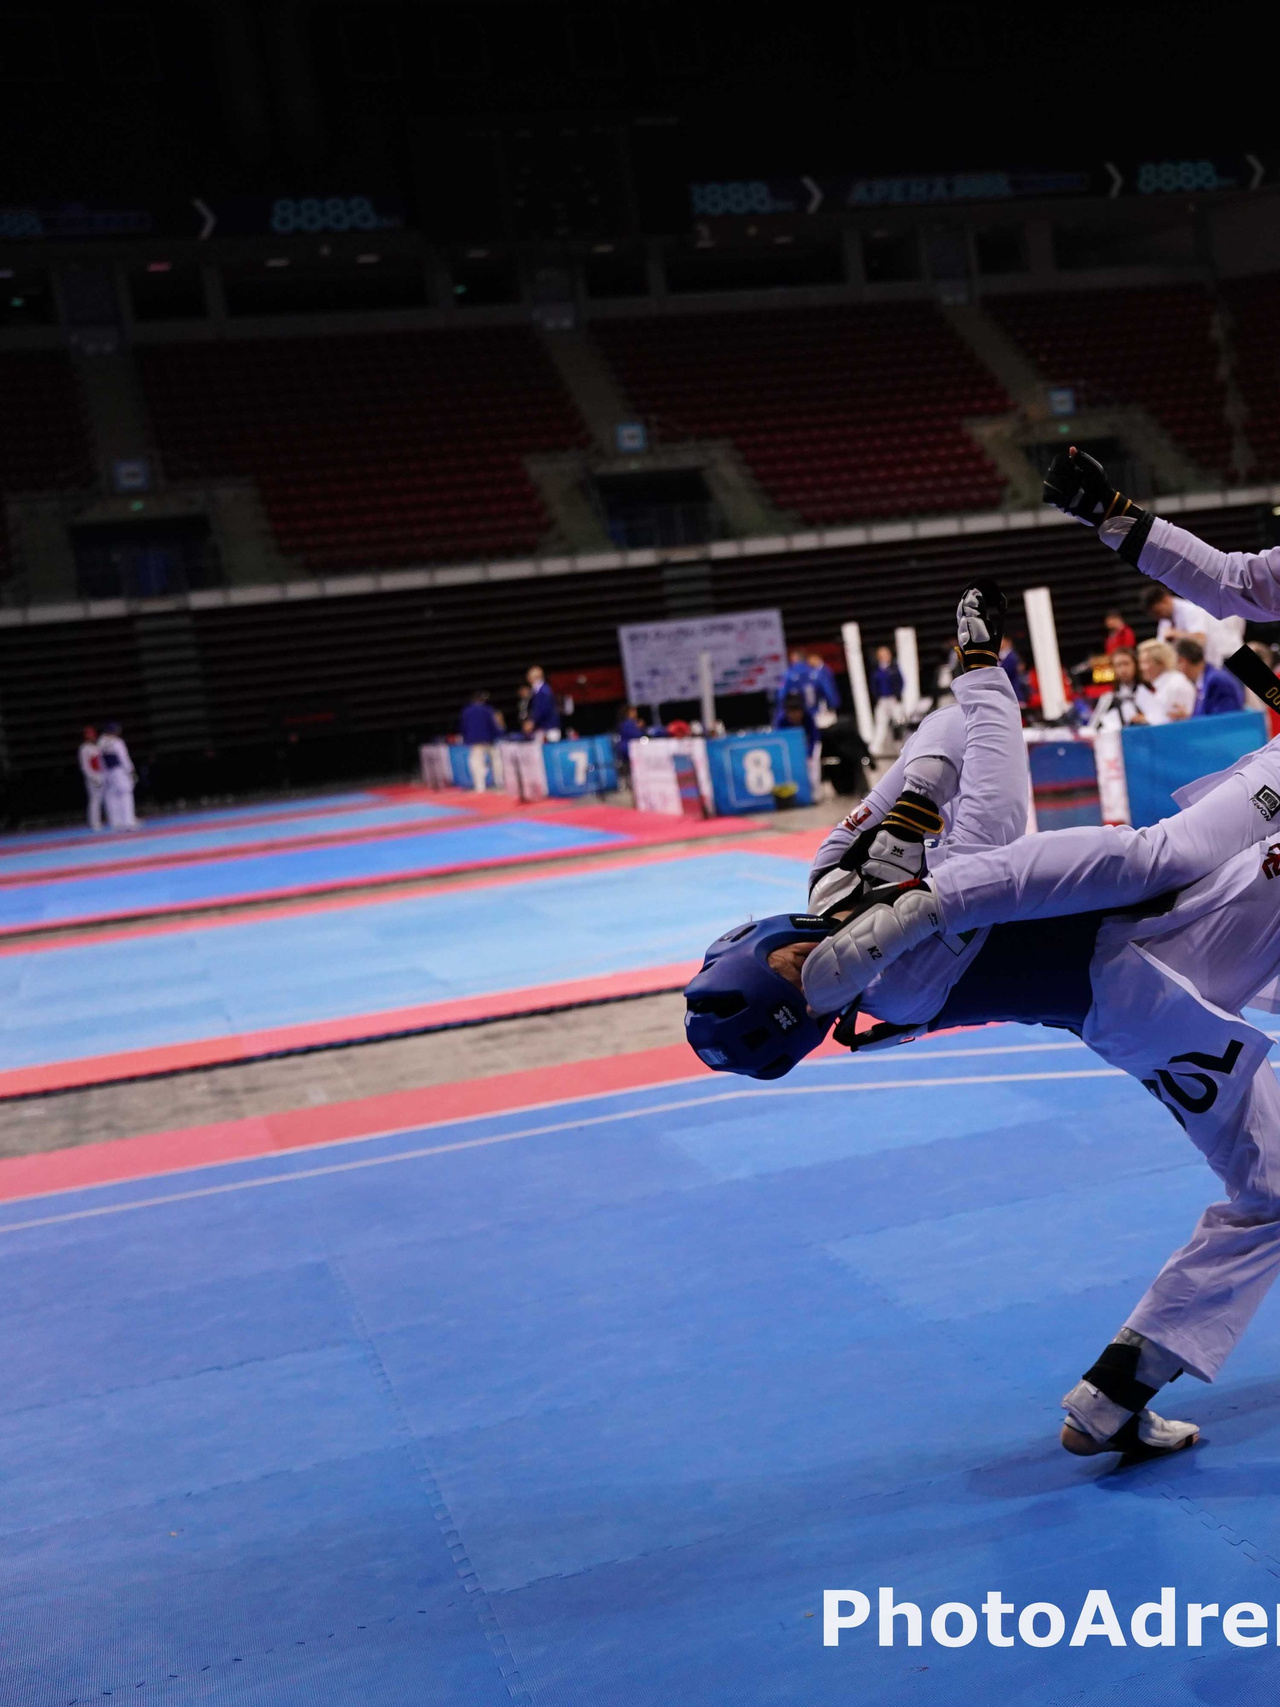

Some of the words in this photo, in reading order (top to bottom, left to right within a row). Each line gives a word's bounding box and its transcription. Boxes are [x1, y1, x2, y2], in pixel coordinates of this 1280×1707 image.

[1138, 161, 1218, 193] 8888
[271, 197, 377, 231] 8888
[568, 750, 590, 786] 7
[742, 748, 776, 797] 8
[867, 945, 883, 961] K2
